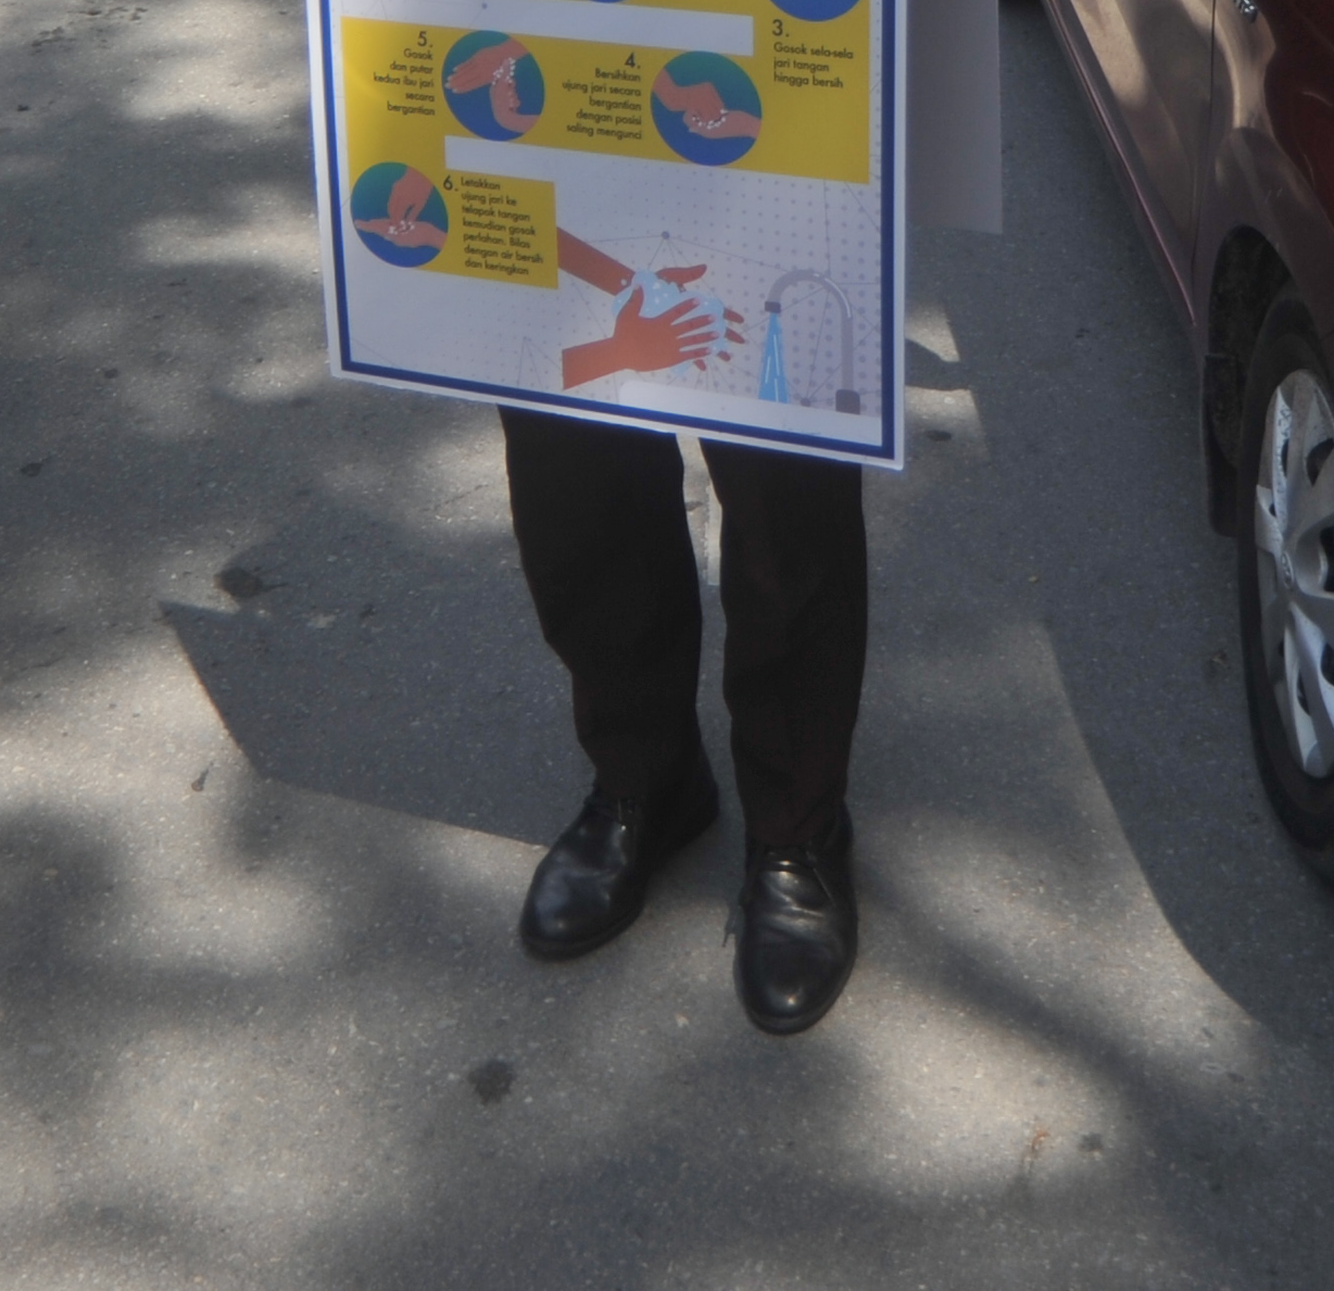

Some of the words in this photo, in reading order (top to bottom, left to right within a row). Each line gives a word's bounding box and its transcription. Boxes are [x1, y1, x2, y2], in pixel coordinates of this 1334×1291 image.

[772, 19, 789, 37] 3.
[417, 31, 433, 48] 5.
[403, 48, 433, 60] Gosok
[774, 41, 807, 55] Gosok
[811, 45, 853, 59] sela-sela
[390, 60, 407, 71] dan
[410, 65, 433, 74] putar
[624, 52, 641, 69] 4.
[773, 56, 790, 69] jari
[793, 59, 829, 74] tangan
[373, 72, 400, 84] kedua
[419, 77, 434, 89] jari
[595, 67, 641, 82] Bersihkan
[774, 70, 809, 87] hingga
[812, 74, 843, 89] bersih
[562, 79, 588, 93] ujung
[590, 82, 606, 94] jari
[609, 86, 641, 96] secara
[405, 92, 435, 102] secara
[589, 95, 641, 111] bergantian
[387, 100, 435, 116] bergantian
[576, 108, 612, 124] dengan
[616, 115, 642, 125] posisi
[566, 122, 594, 137] saling
[597, 127, 642, 140] mengunci
[443, 175, 459, 191] 6.
[461, 176, 500, 190] Letakkan
[461, 192, 486, 205] ujung
[488, 194, 504, 206] jari
[506, 196, 517, 206] ke
[462, 204, 495, 218] telapak
[498, 209, 530, 223] tangan
[462, 217, 506, 231] kemudian
[508, 225, 536, 236] gosok
[509, 236, 531, 248] Bilas
[464, 244, 498, 259] dengan
[501, 251, 513, 259] air
[515, 251, 544, 264] bersih
[465, 257, 482, 268] dan
[485, 260, 529, 275] keringkan
